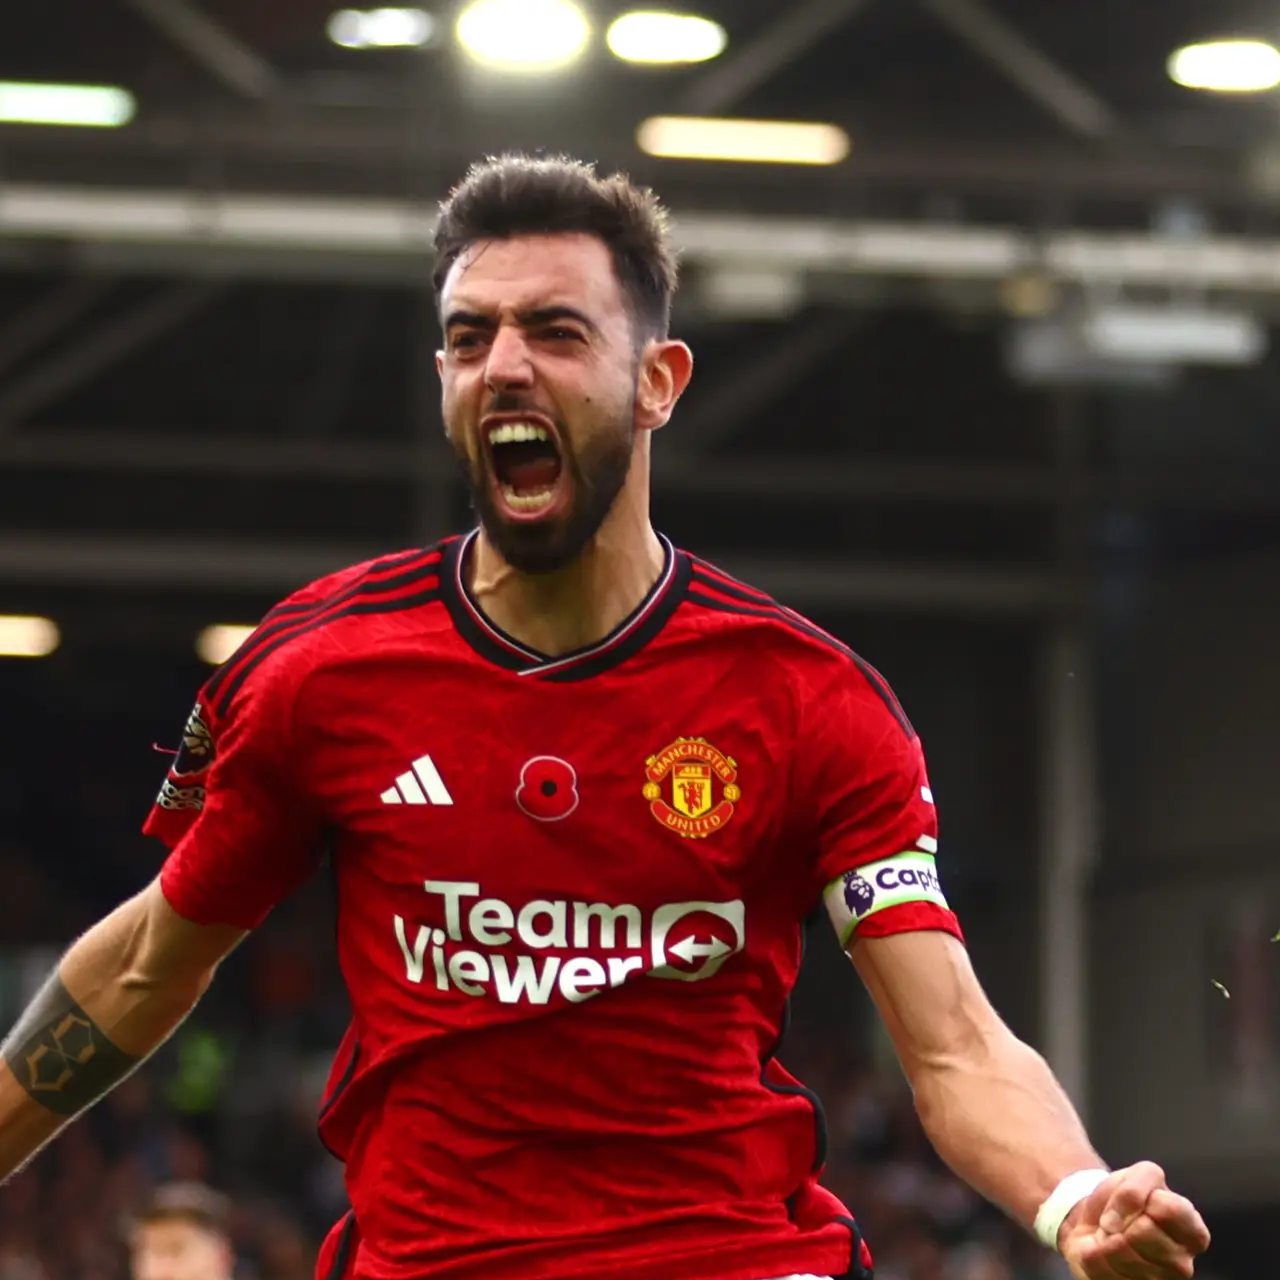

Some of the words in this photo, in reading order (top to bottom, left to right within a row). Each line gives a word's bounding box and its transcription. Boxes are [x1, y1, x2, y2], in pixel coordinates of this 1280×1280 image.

[652, 744, 731, 779] MANCHESTER
[666, 813, 721, 833] UNITED
[424, 879, 642, 949] Team
[393, 914, 643, 1005] Viewer
